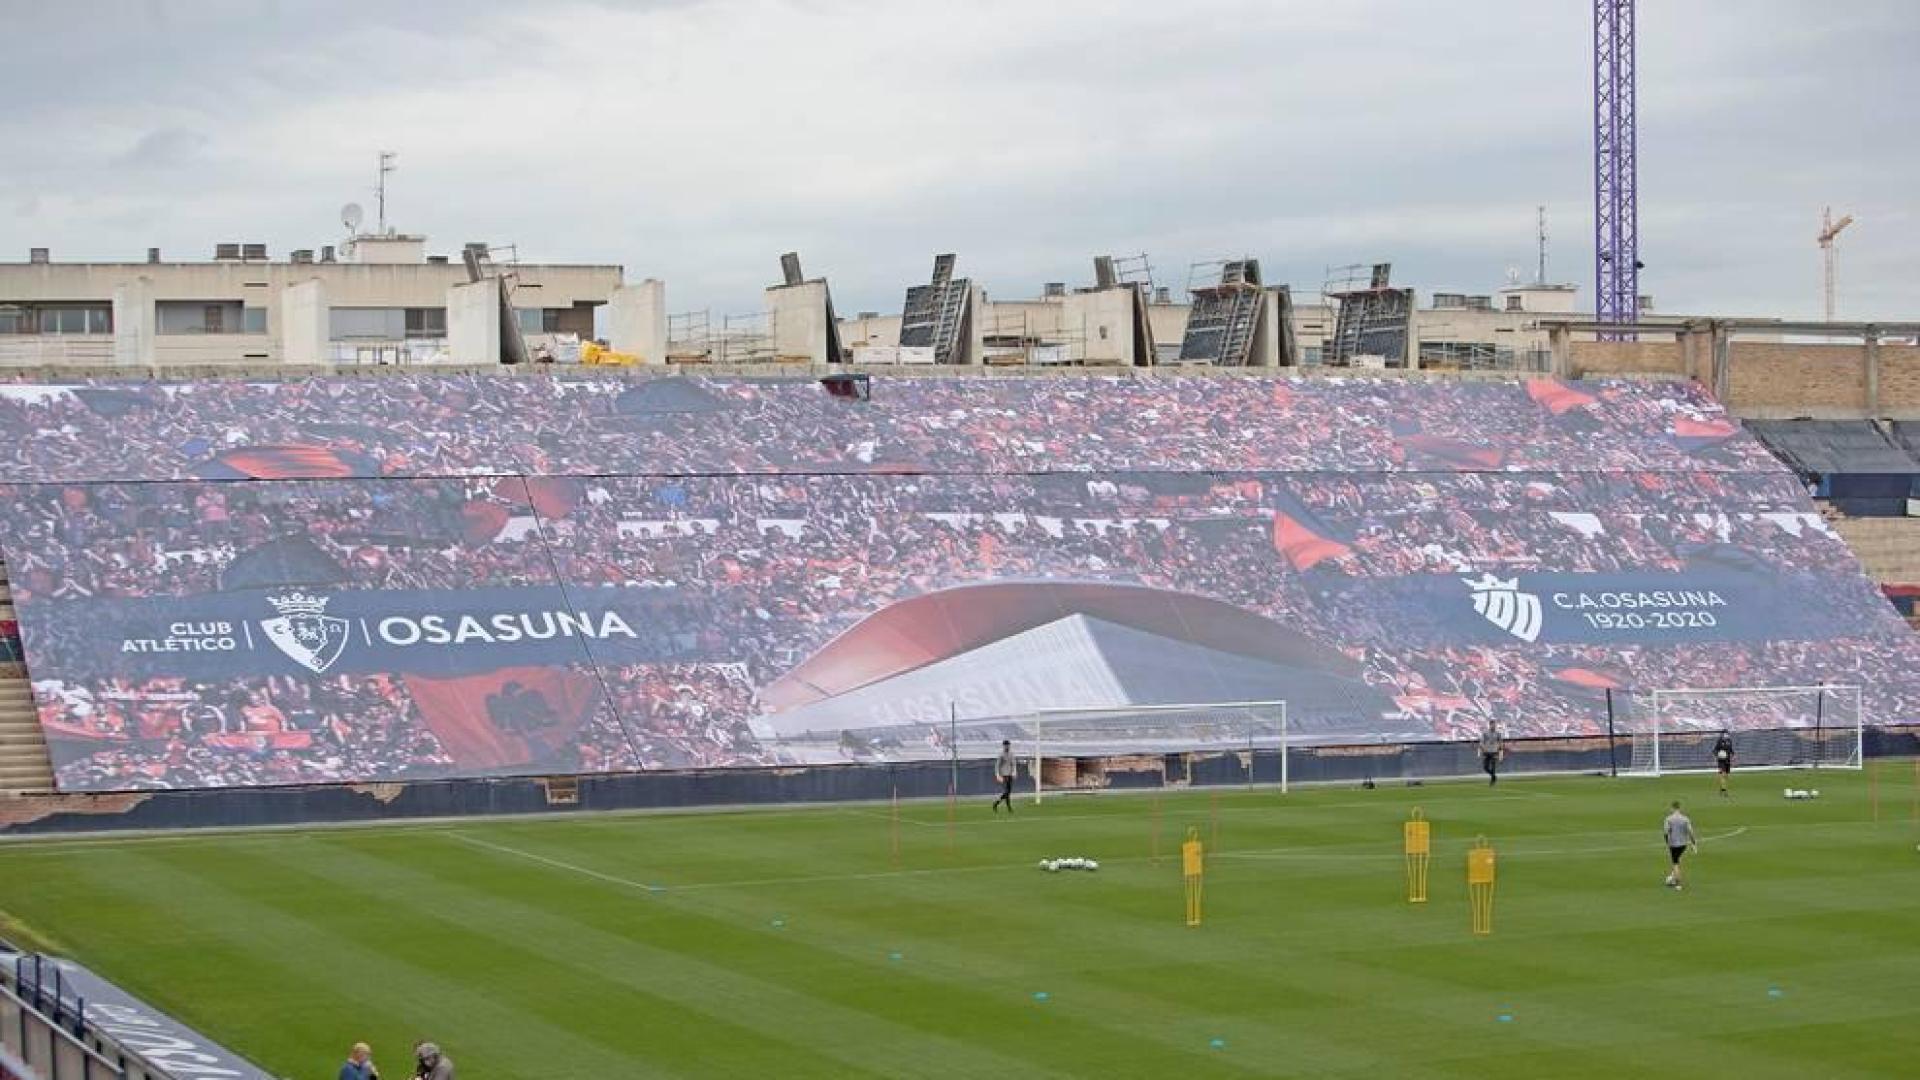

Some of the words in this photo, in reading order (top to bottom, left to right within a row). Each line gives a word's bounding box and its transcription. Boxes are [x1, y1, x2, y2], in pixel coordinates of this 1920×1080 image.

[171, 621, 232, 636] CLUB
[379, 609, 638, 646] OSASUNA
[1584, 612, 1717, 629] 1920-2020
[122, 637, 236, 652] ATLÉTICO
